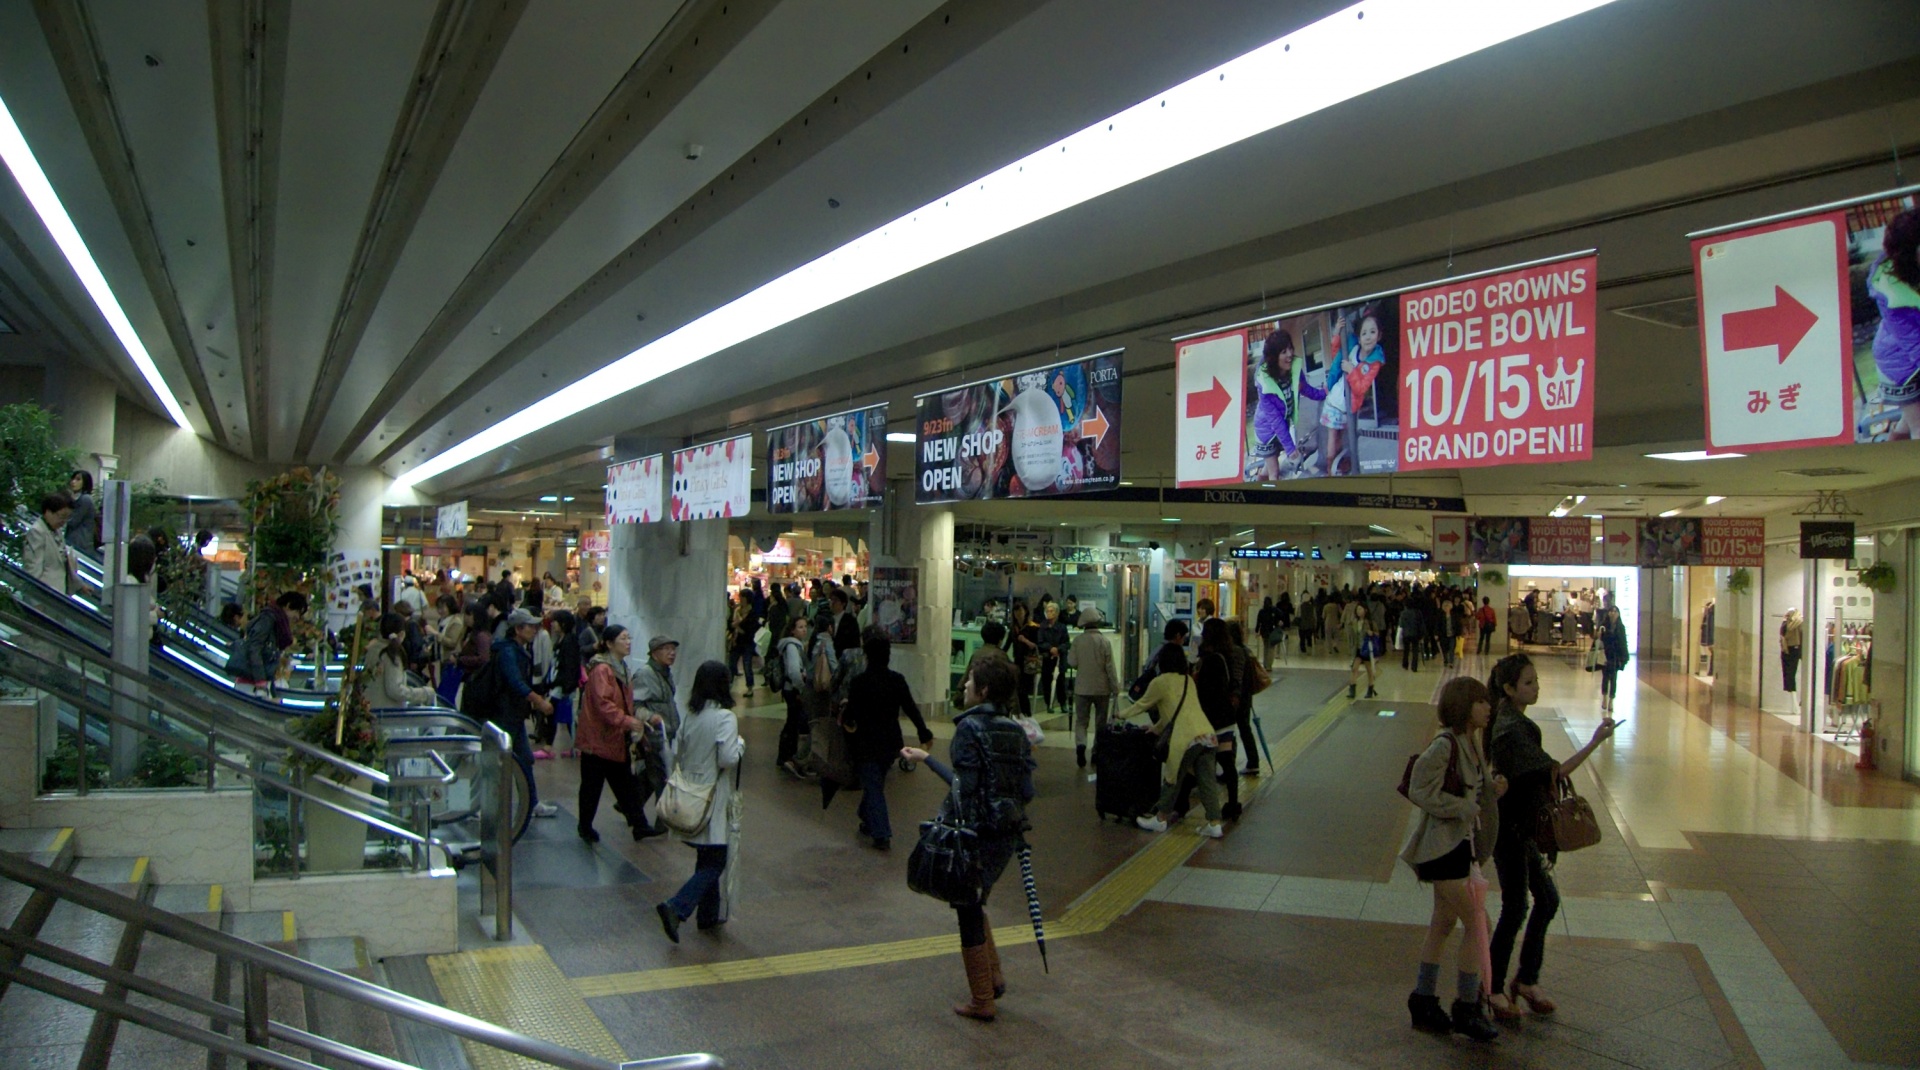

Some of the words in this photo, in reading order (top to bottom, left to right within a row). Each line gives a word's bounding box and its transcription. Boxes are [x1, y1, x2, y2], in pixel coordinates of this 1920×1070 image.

[1406, 289, 1476, 323] RODEO
[1484, 268, 1587, 309] CROWNS
[1407, 316, 1483, 359] WIDE
[1490, 301, 1586, 347] BOWL
[1090, 367, 1118, 384] PORTA
[1405, 353, 1531, 429] 10/15
[1546, 378, 1575, 406] SAT
[1746, 382, 1802, 414] みぎ
[923, 437, 957, 463] NEW
[962, 429, 1003, 457] SHOP
[1195, 441, 1222, 461] みぎ
[1404, 430, 1489, 463] GRAND
[773, 462, 794, 482] NEW
[795, 458, 821, 478] SHOP
[922, 466, 962, 492] OPEN
[772, 485, 796, 504] OPEN
[1204, 490, 1247, 503] PORTA
[1530, 527, 1558, 536] WIDE
[1559, 527, 1589, 536] BOWL
[1703, 527, 1731, 537] WIDE
[1732, 527, 1763, 537] BOWL
[1530, 537, 1573, 554] 10/15
[1703, 538, 1746, 555] 10/15
